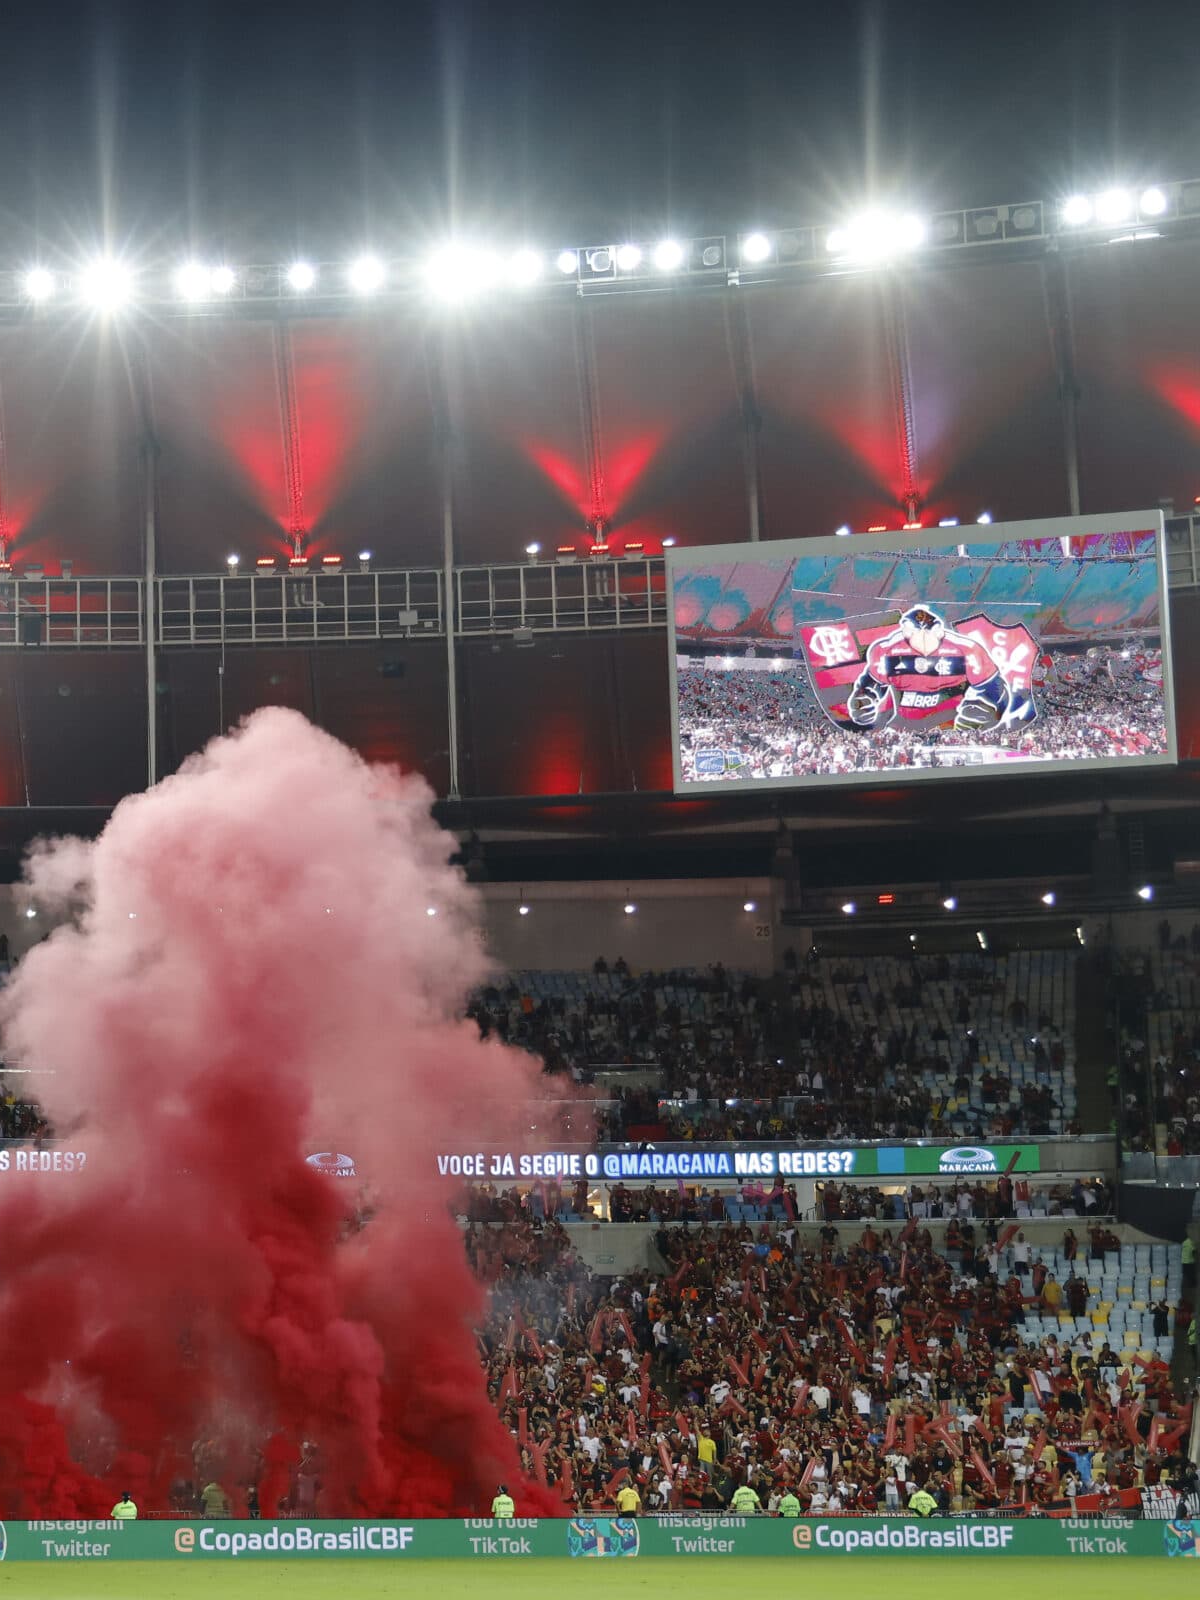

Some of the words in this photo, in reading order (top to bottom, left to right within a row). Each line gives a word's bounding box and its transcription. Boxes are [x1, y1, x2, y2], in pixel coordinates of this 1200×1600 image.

[16, 1151, 87, 1172] REDES?
[437, 1153, 485, 1176] VOCÊ
[490, 1153, 516, 1176] JÁ
[519, 1154, 581, 1176] SEGUE
[585, 1154, 598, 1176] O
[734, 1152, 773, 1175] NAS
[778, 1151, 854, 1175] REDES?
[174, 1525, 414, 1556] @CopadoBrasilCBF
[469, 1536, 532, 1555] TikTok
[671, 1536, 736, 1553] Twitter
[792, 1523, 1014, 1552] @CopadoBrasilCBF
[1066, 1536, 1128, 1554] TikTok
[41, 1539, 111, 1557] Twitter
